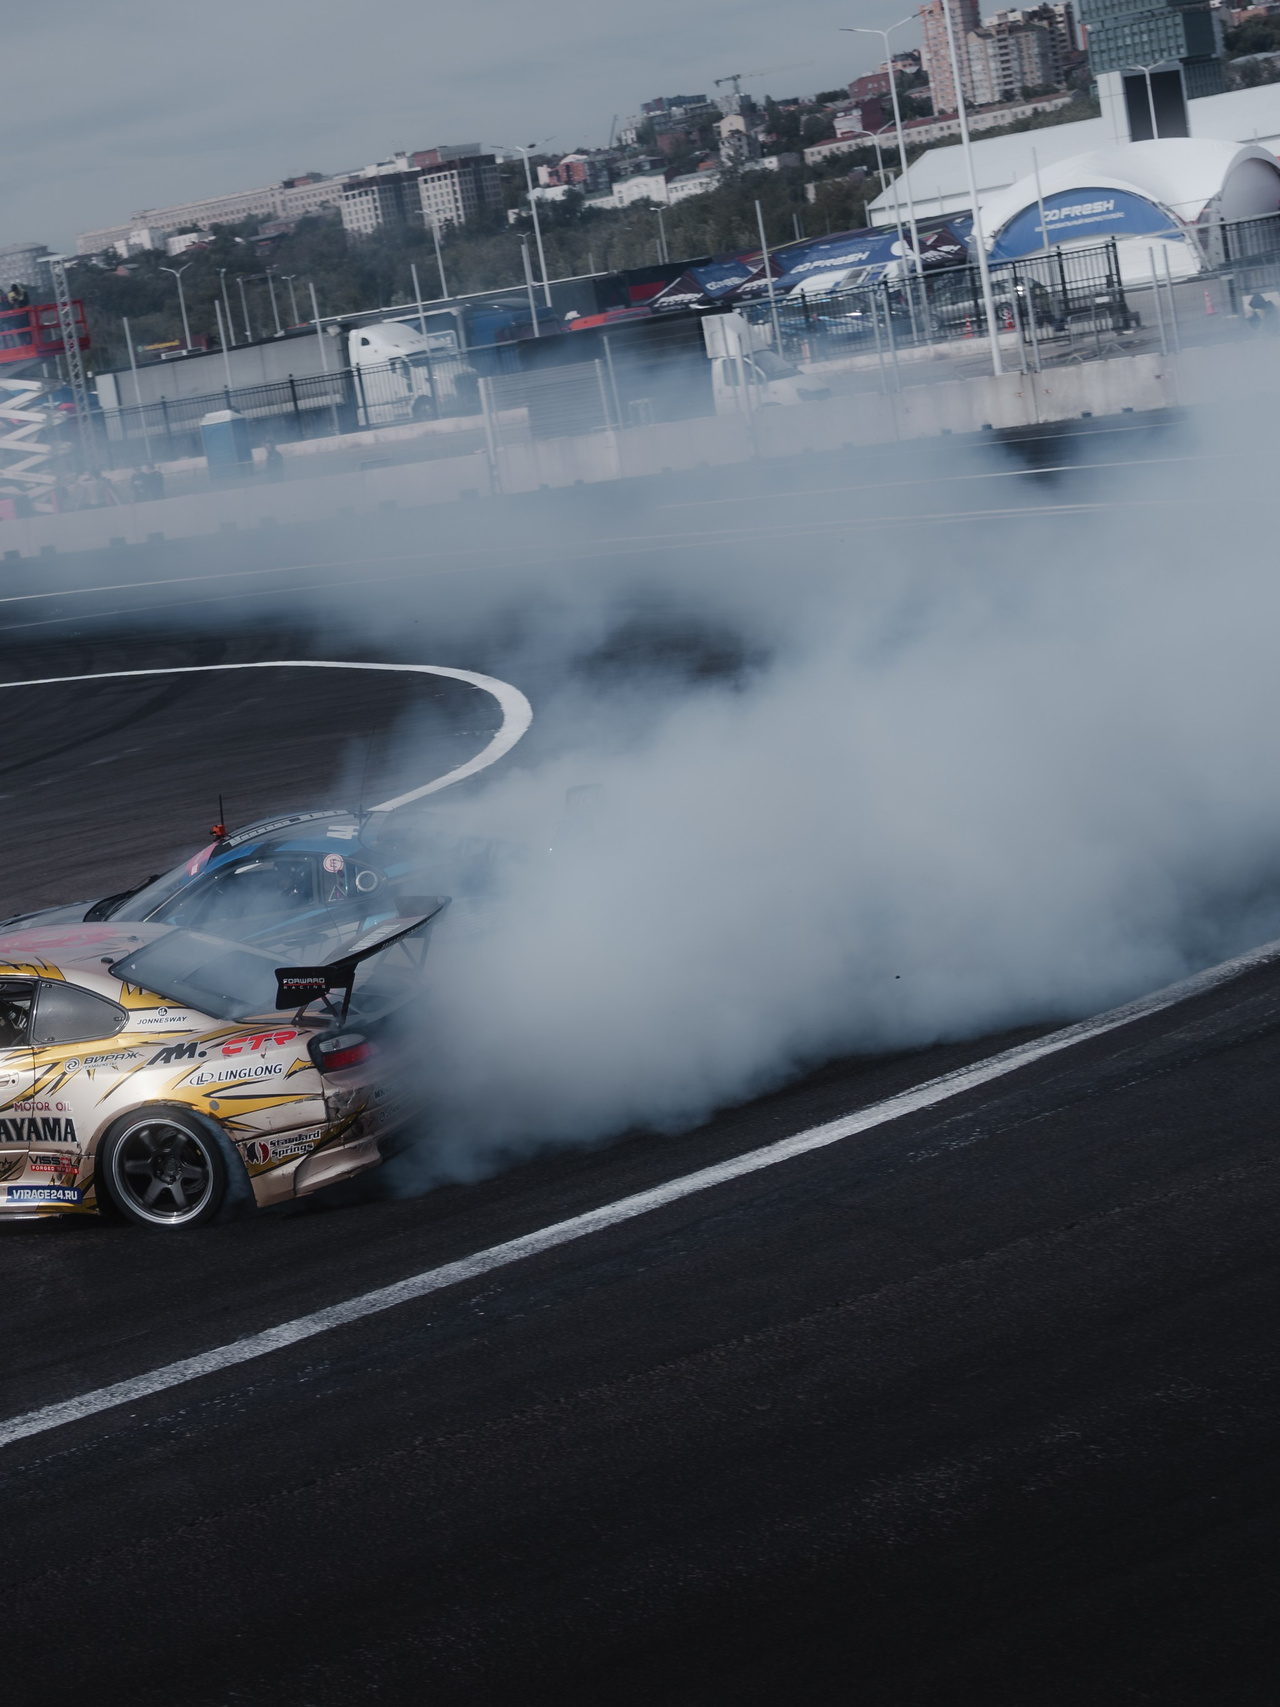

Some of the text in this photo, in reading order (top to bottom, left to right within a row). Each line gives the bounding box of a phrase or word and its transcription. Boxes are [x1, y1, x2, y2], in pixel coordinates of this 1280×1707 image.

[137, 1016, 187, 1025] JONNESWAY
[221, 1030, 297, 1055] CTR
[83, 1052, 140, 1065] ВИРАЖ
[218, 1064, 283, 1081] LINGLONG
[14, 1101, 72, 1112] MOTOR OIL
[269, 1130, 320, 1147] Standard
[271, 1143, 313, 1158] Springs
[12, 1189, 78, 1201] VIRAGE24.RU
